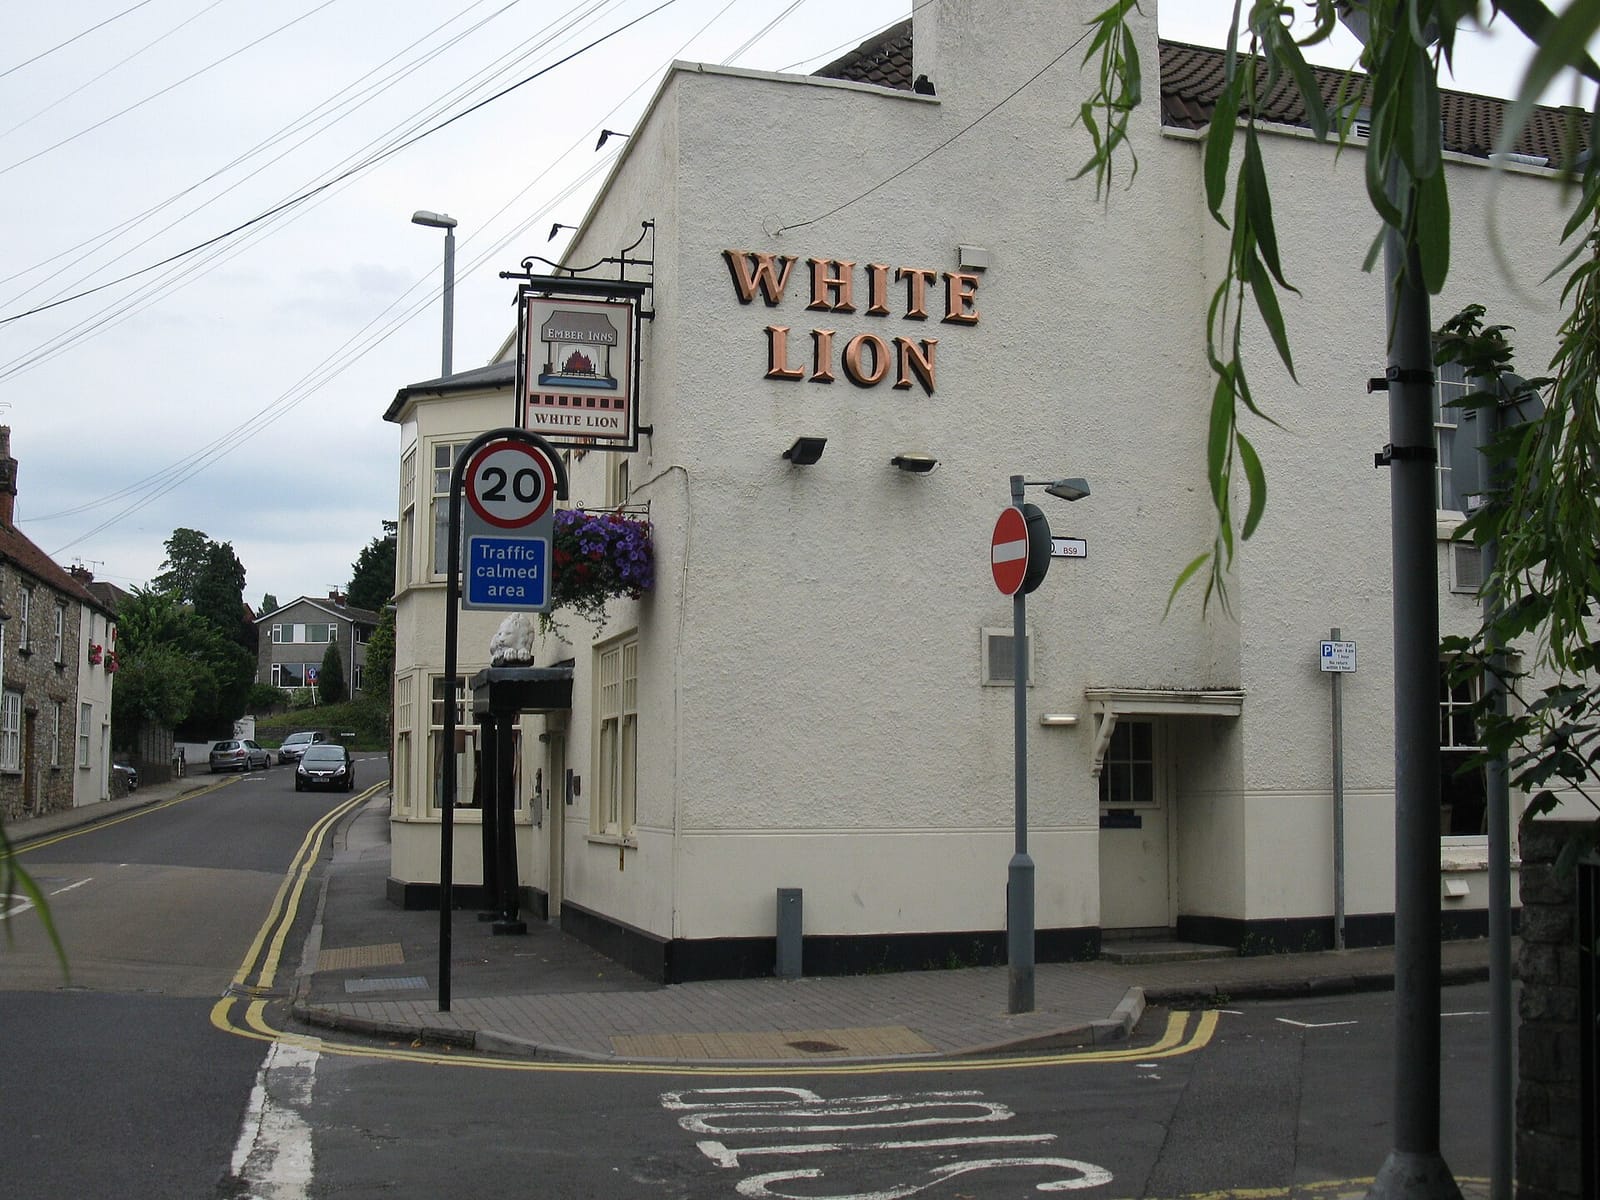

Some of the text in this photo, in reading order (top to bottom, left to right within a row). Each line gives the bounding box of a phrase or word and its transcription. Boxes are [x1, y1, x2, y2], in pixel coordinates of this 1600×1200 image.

[721, 250, 980, 326] WHITE
[764, 325, 940, 397] LION
[534, 413, 618, 429] WHITE LION
[481, 466, 542, 504] 20
[480, 544, 535, 561] Traffic
[1063, 547, 1078, 555] BS9
[476, 563, 538, 579] calmed
[487, 585, 525, 597] area
[659, 1086, 1115, 1200] STOP
